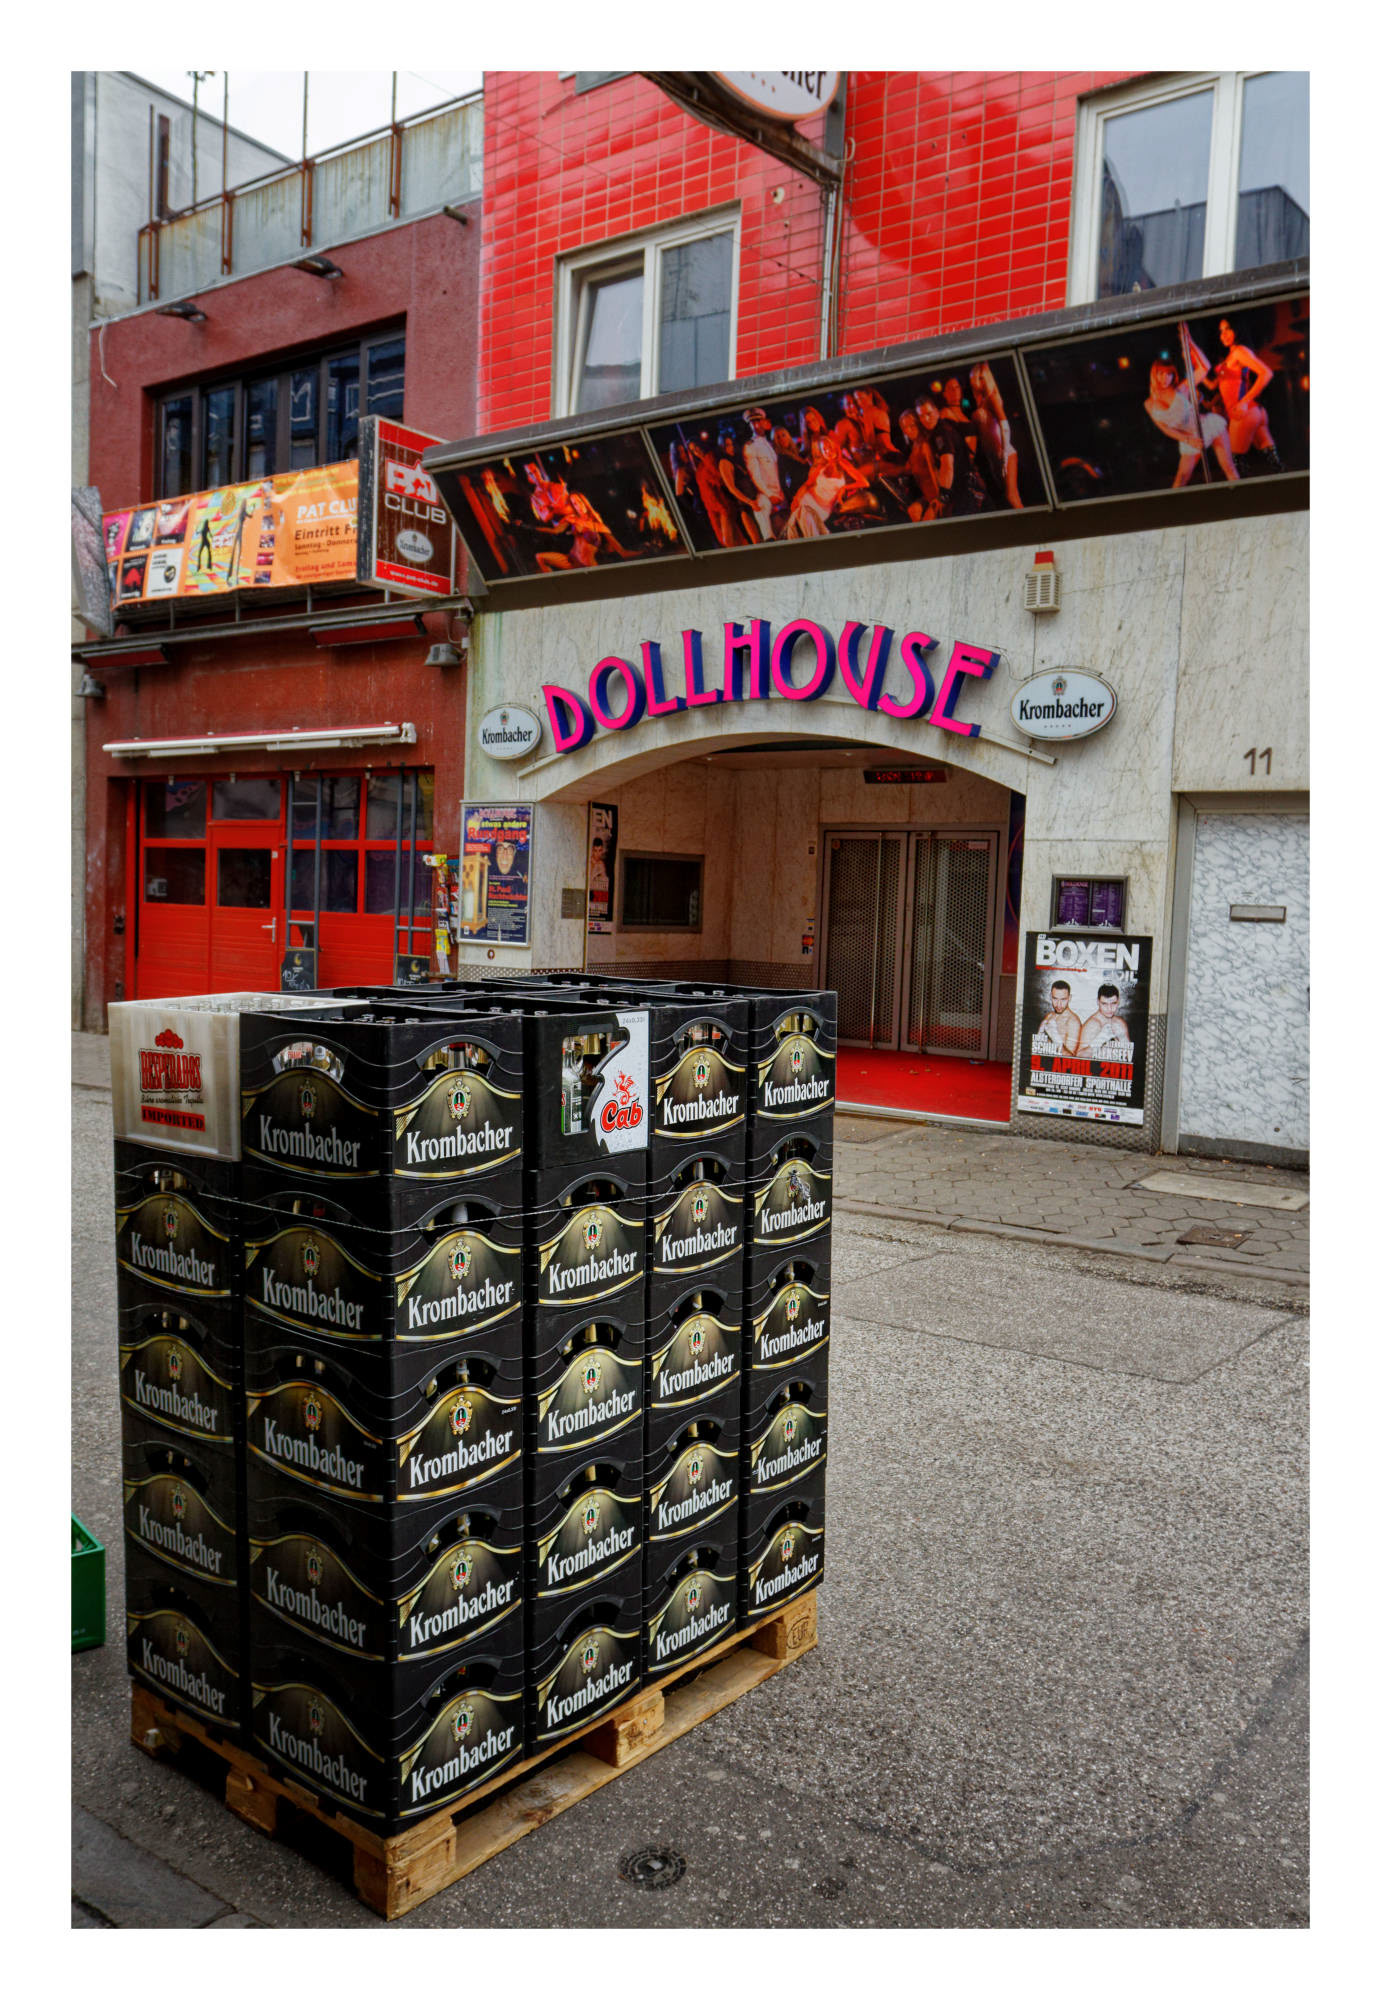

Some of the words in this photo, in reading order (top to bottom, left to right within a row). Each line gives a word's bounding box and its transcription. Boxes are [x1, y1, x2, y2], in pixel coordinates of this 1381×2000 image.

[297, 501, 327, 520] PAT
[329, 496, 358, 514] CLU
[385, 493, 447, 525] CLUB
[294, 525, 340, 541] Eintritt
[542, 618, 1000, 753] DOLLHOUSE
[1019, 697, 1104, 720] Krombacher
[482, 726, 533, 745] Krombacher
[1243, 747, 1273, 776] 11
[467, 827, 528, 843] Rundgang
[1036, 939, 1140, 970] BOXEN
[140, 1050, 202, 1090] DESPERADOS
[1031, 1054, 1045, 1071] 9.
[1052, 1056, 1093, 1076] APRIL
[1100, 1061, 1134, 1080] 2011
[1031, 1071, 1083, 1087] ALSTERDORFER
[1085, 1077, 1132, 1092] SPORTHALLE
[663, 1091, 739, 1125] Krombacher
[764, 1075, 829, 1107] Krombacher
[142, 1108, 204, 1129] IMPORTED
[600, 1097, 643, 1133] Cab
[260, 1115, 360, 1167] Krombacher
[407, 1121, 513, 1164] Krombacher
[761, 1198, 825, 1234] Krombacher
[131, 1232, 215, 1286] Krombacher
[662, 1223, 737, 1262] Krombacher
[549, 1248, 637, 1294] Krombacher
[262, 1267, 364, 1330] Krombacher
[408, 1278, 513, 1329] Krombacher
[760, 1318, 825, 1360] Krombacher
[660, 1351, 734, 1398] Krombacher
[135, 1370, 217, 1432] Krombacher
[548, 1389, 635, 1441] Krombacher
[264, 1417, 364, 1488] Krombacher
[410, 1429, 513, 1488] Krombacher
[757, 1437, 822, 1484] Krombacher
[658, 1478, 733, 1530] Krombacher
[139, 1505, 222, 1574] Krombacher
[547, 1526, 635, 1585] Krombacher
[755, 1553, 818, 1605] Krombacher
[266, 1567, 366, 1648] Krombacher
[410, 1580, 514, 1648] Krombacher
[656, 1602, 730, 1661] Krombacher
[142, 1638, 225, 1715] Krombacher
[546, 1660, 633, 1729] Krombacher
[269, 1712, 367, 1801] Krombacher
[411, 1725, 514, 1803] Krombacher
